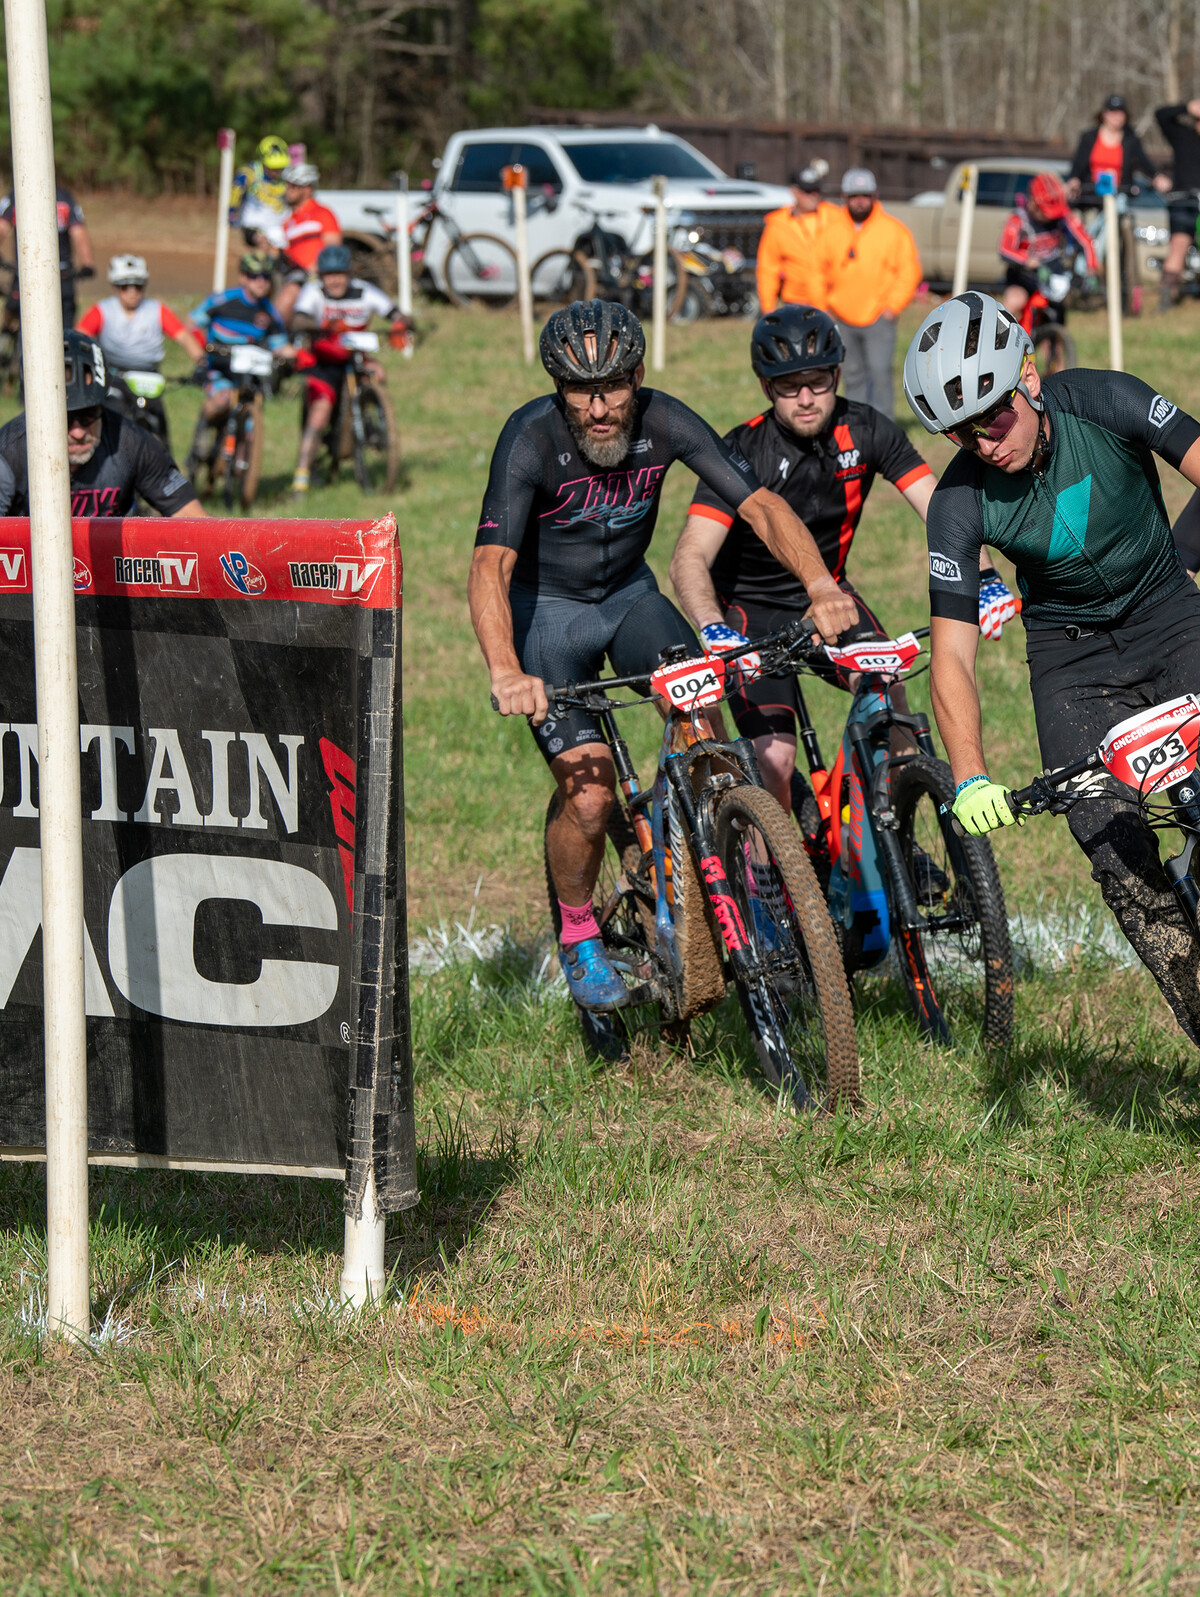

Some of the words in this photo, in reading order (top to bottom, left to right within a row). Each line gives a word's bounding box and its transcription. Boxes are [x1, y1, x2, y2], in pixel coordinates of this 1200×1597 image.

[860, 656, 899, 666] 407
[671, 672, 717, 699] 004
[1112, 702, 1197, 752] GNCCRACING.COM
[1131, 738, 1184, 775] 003
[1168, 764, 1188, 781] PRO
